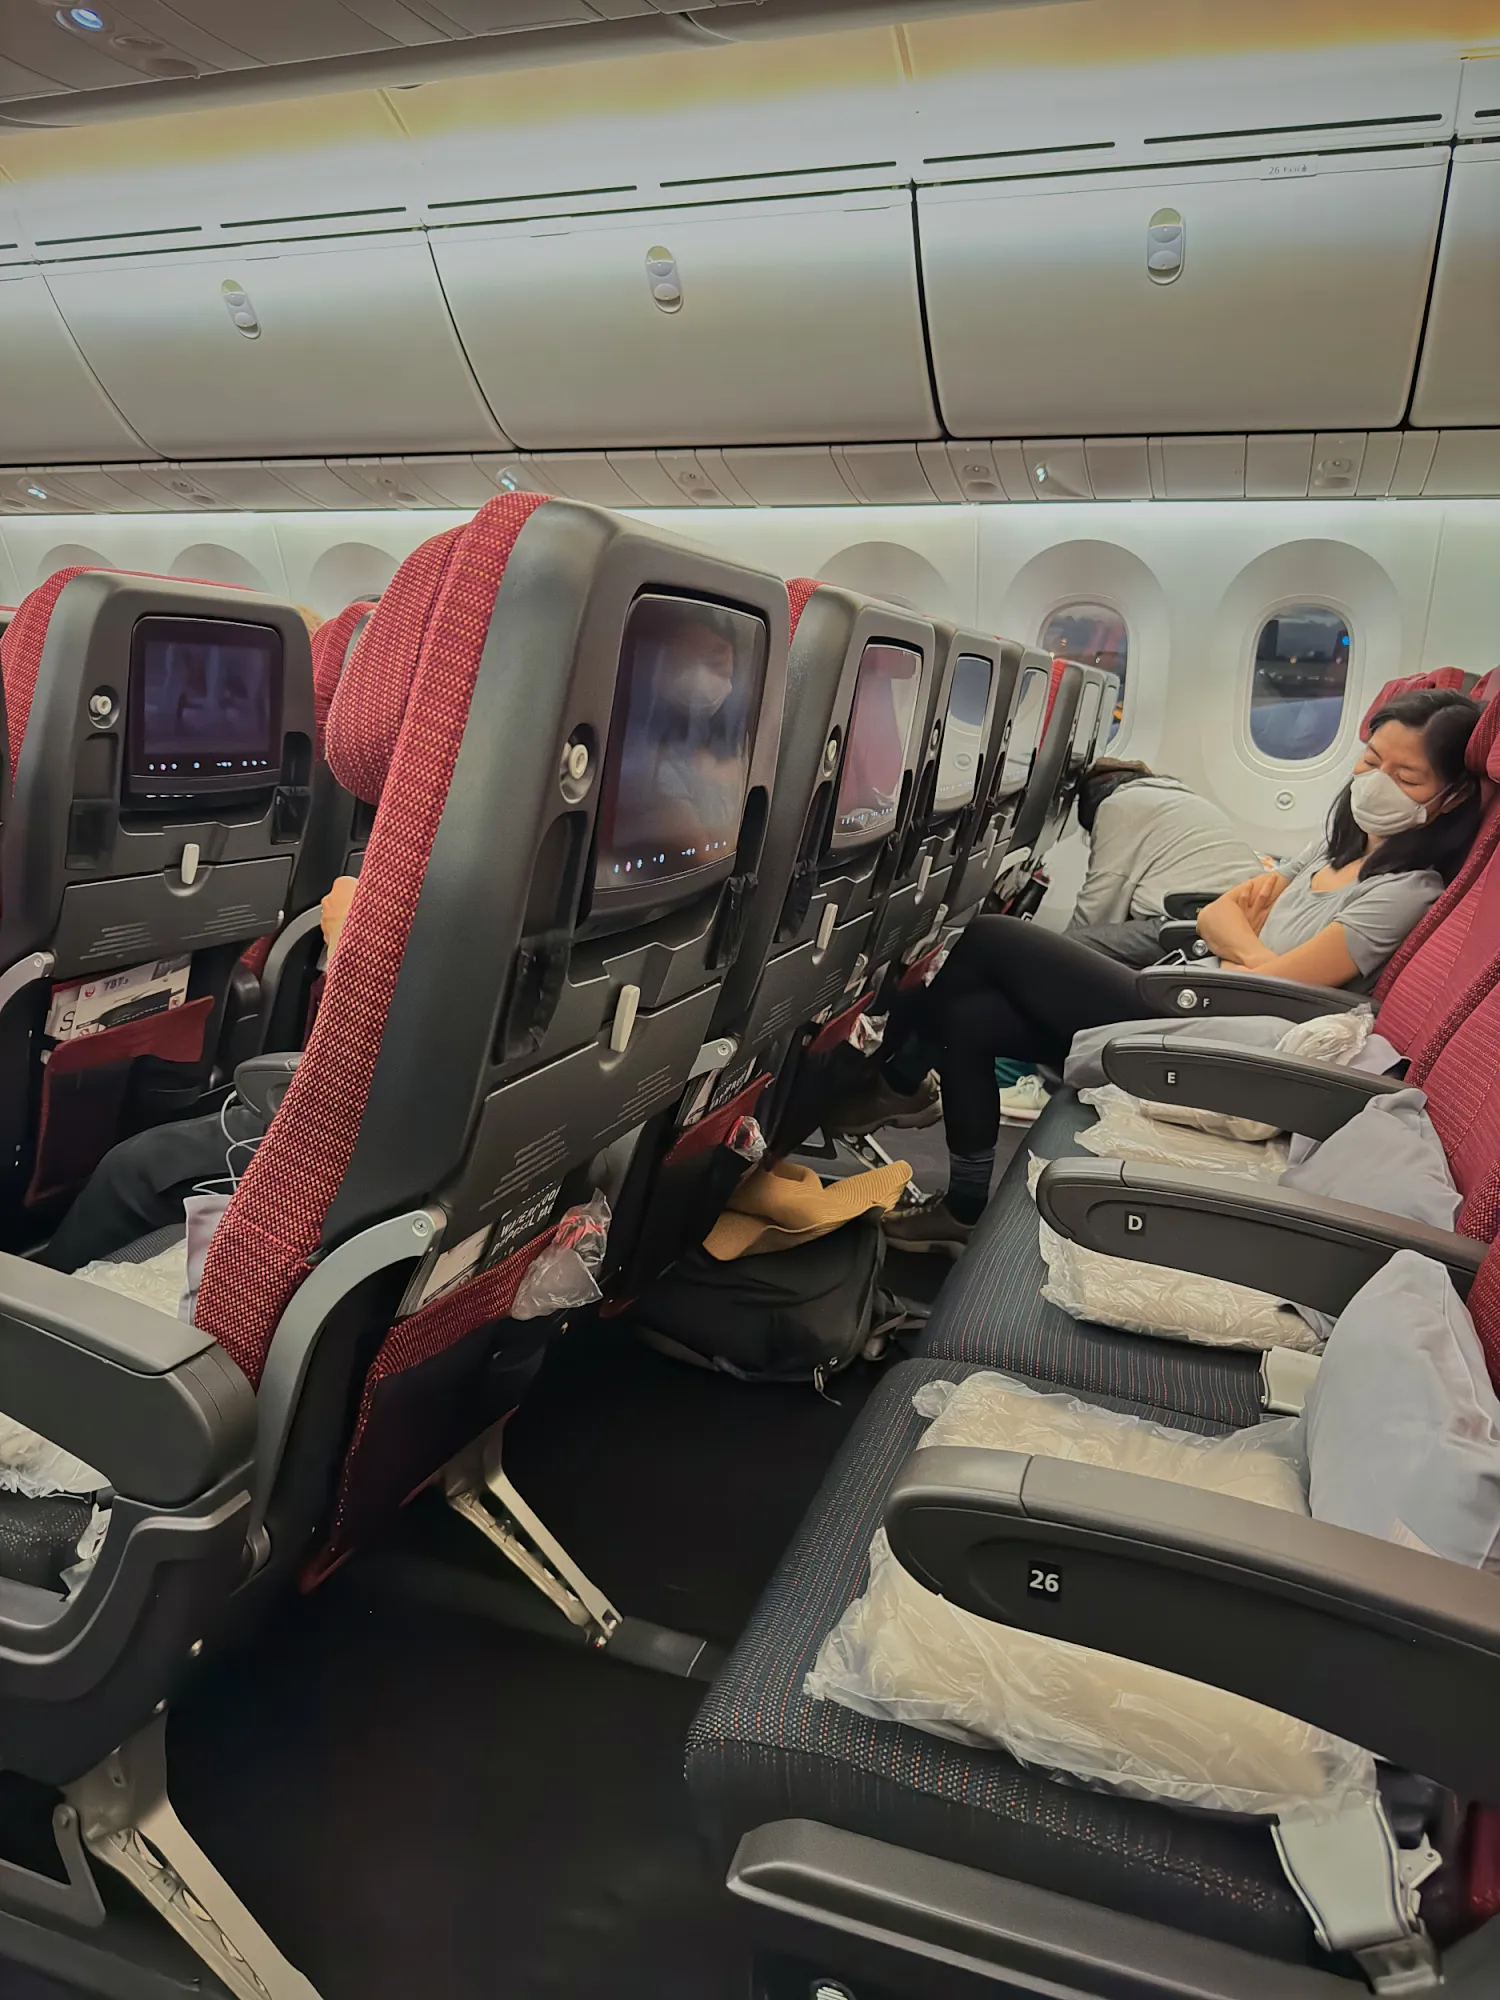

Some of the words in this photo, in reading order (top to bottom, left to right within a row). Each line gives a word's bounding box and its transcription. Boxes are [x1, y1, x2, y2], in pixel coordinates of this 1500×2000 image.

[1203, 998, 1210, 1008] F
[1167, 1071, 1176, 1084] E
[1128, 1214, 1143, 1231] D
[1029, 1569, 1060, 1593] 26
